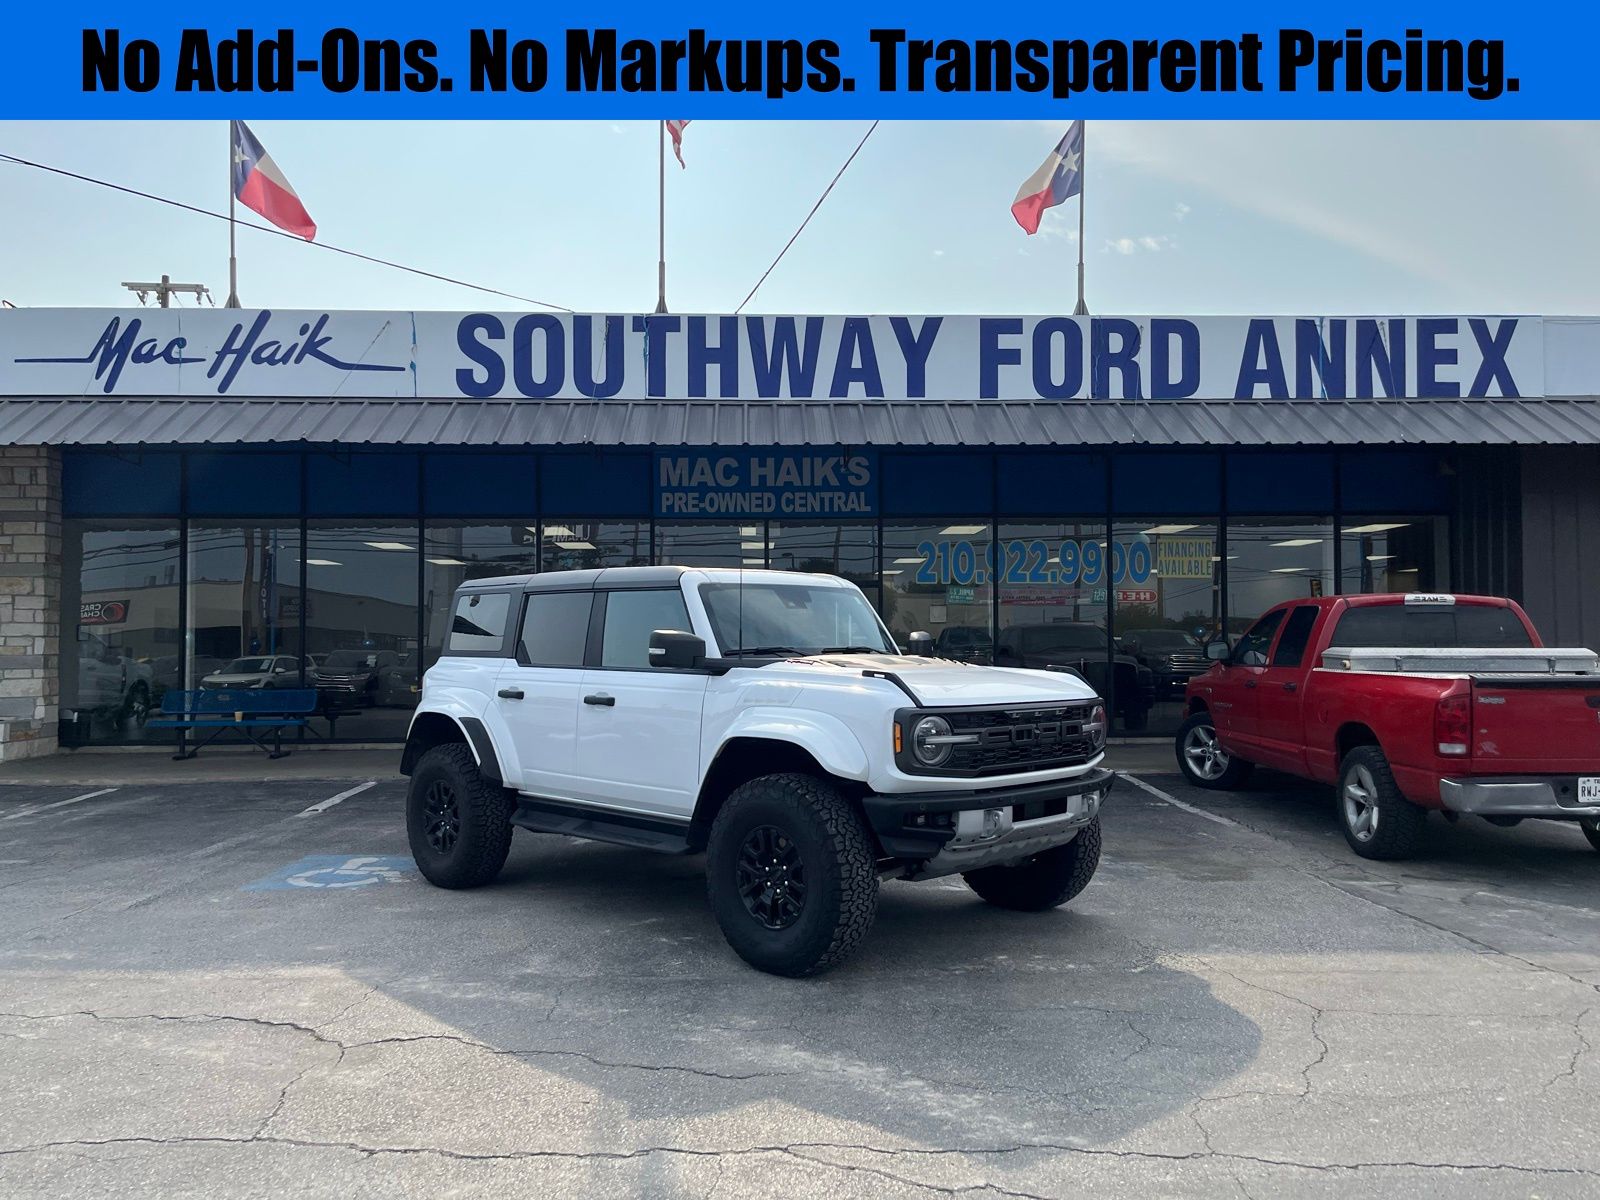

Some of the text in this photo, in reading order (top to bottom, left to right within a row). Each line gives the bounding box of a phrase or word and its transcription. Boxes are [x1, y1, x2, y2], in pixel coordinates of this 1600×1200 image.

[14, 309, 1520, 399] Mac Haik SOUTHWAY FORD ANNEX
[659, 456, 870, 488] MAC HAIK'S
[661, 491, 871, 513] PRE-OWNED CENTRAL
[916, 540, 1151, 584] 210.922.9900
[1158, 542, 1211, 558] FINANCING
[1158, 559, 1211, 576] AVAILABLE
